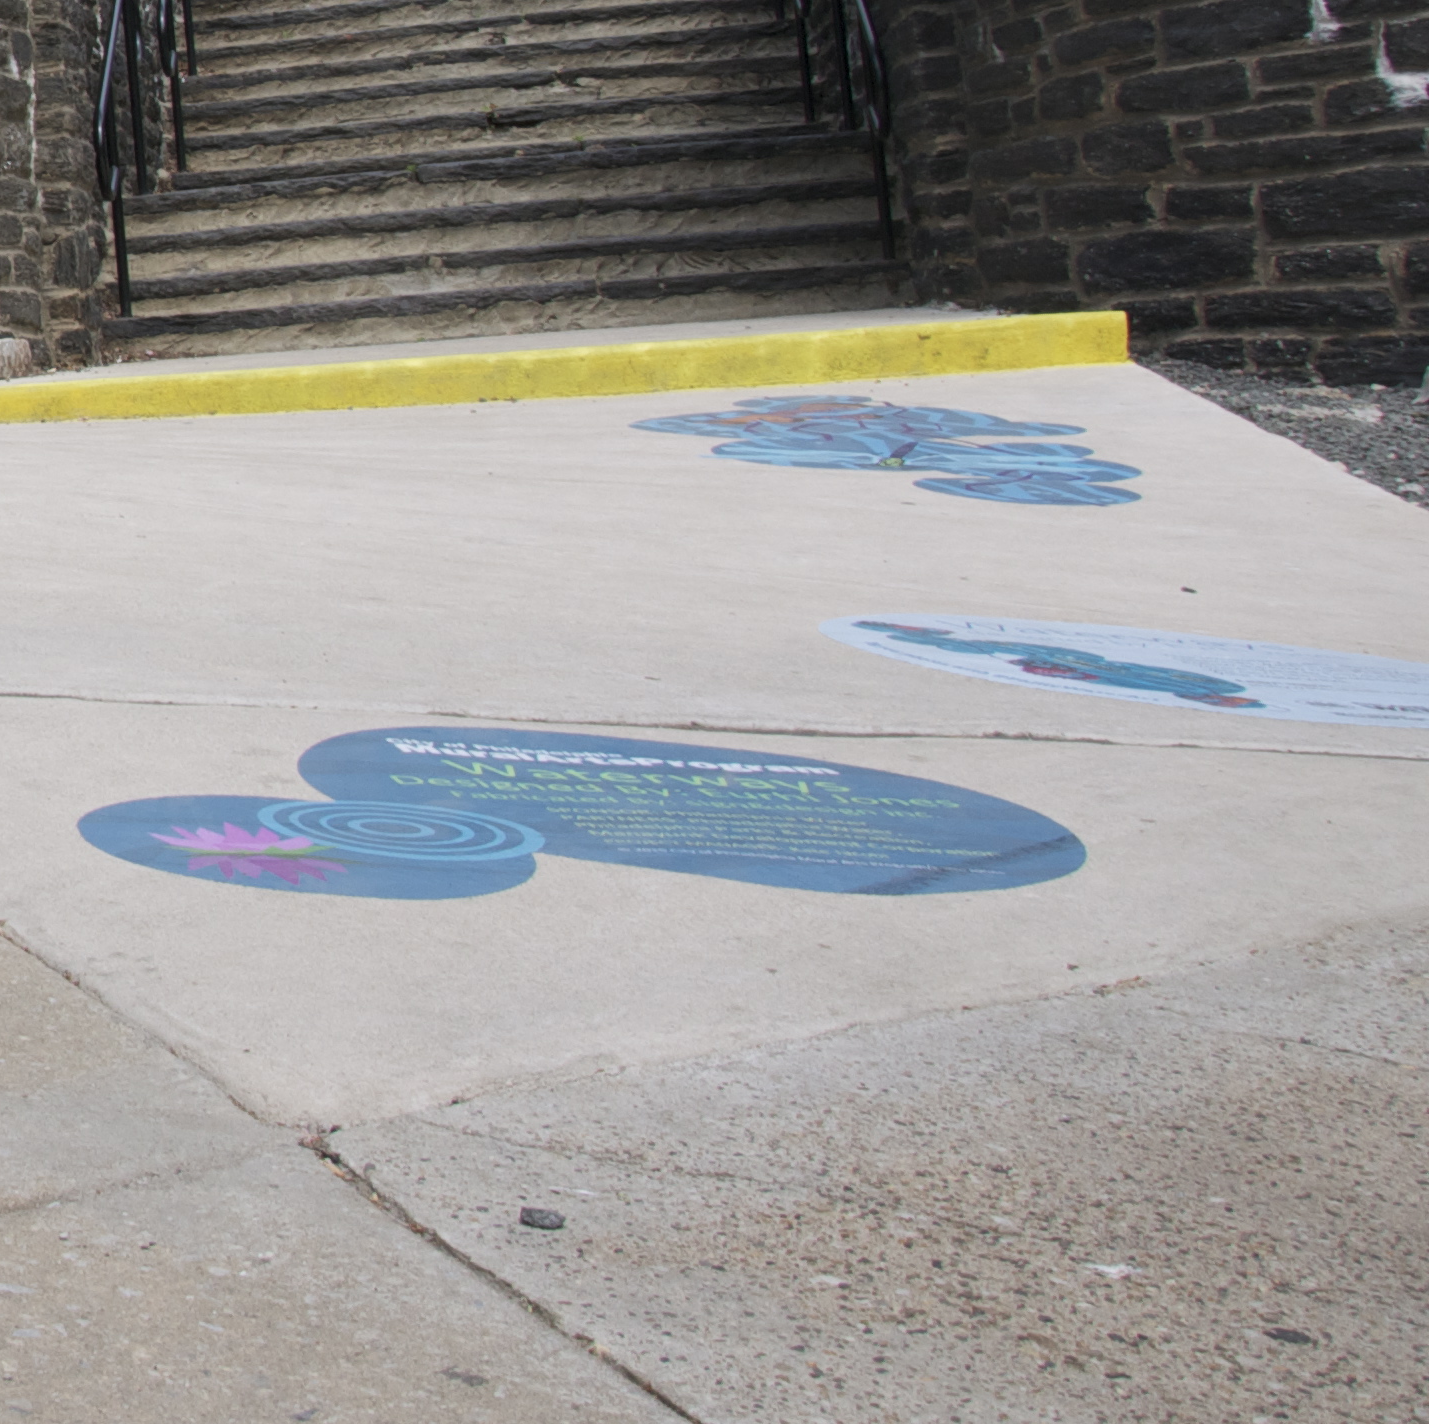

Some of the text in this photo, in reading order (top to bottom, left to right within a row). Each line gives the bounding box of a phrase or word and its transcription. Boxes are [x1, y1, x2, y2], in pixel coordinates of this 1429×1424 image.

[385, 737, 623, 758] City of Philadelphia
[441, 759, 851, 794] Waterways
[390, 774, 960, 809] Designed By: Eurhi Jones
[448, 789, 619, 803] Fabricated
[627, 797, 678, 807] By:
[560, 814, 678, 823] PARTNERS:
[687, 817, 821, 830] Philadelphia
[664, 809, 797, 821] Philadelphia
[802, 816, 867, 826] Water
[574, 822, 711, 831] Philadelphia
[715, 826, 775, 835] Parks
[588, 829, 1001, 856] Manayunk Development Corporation
